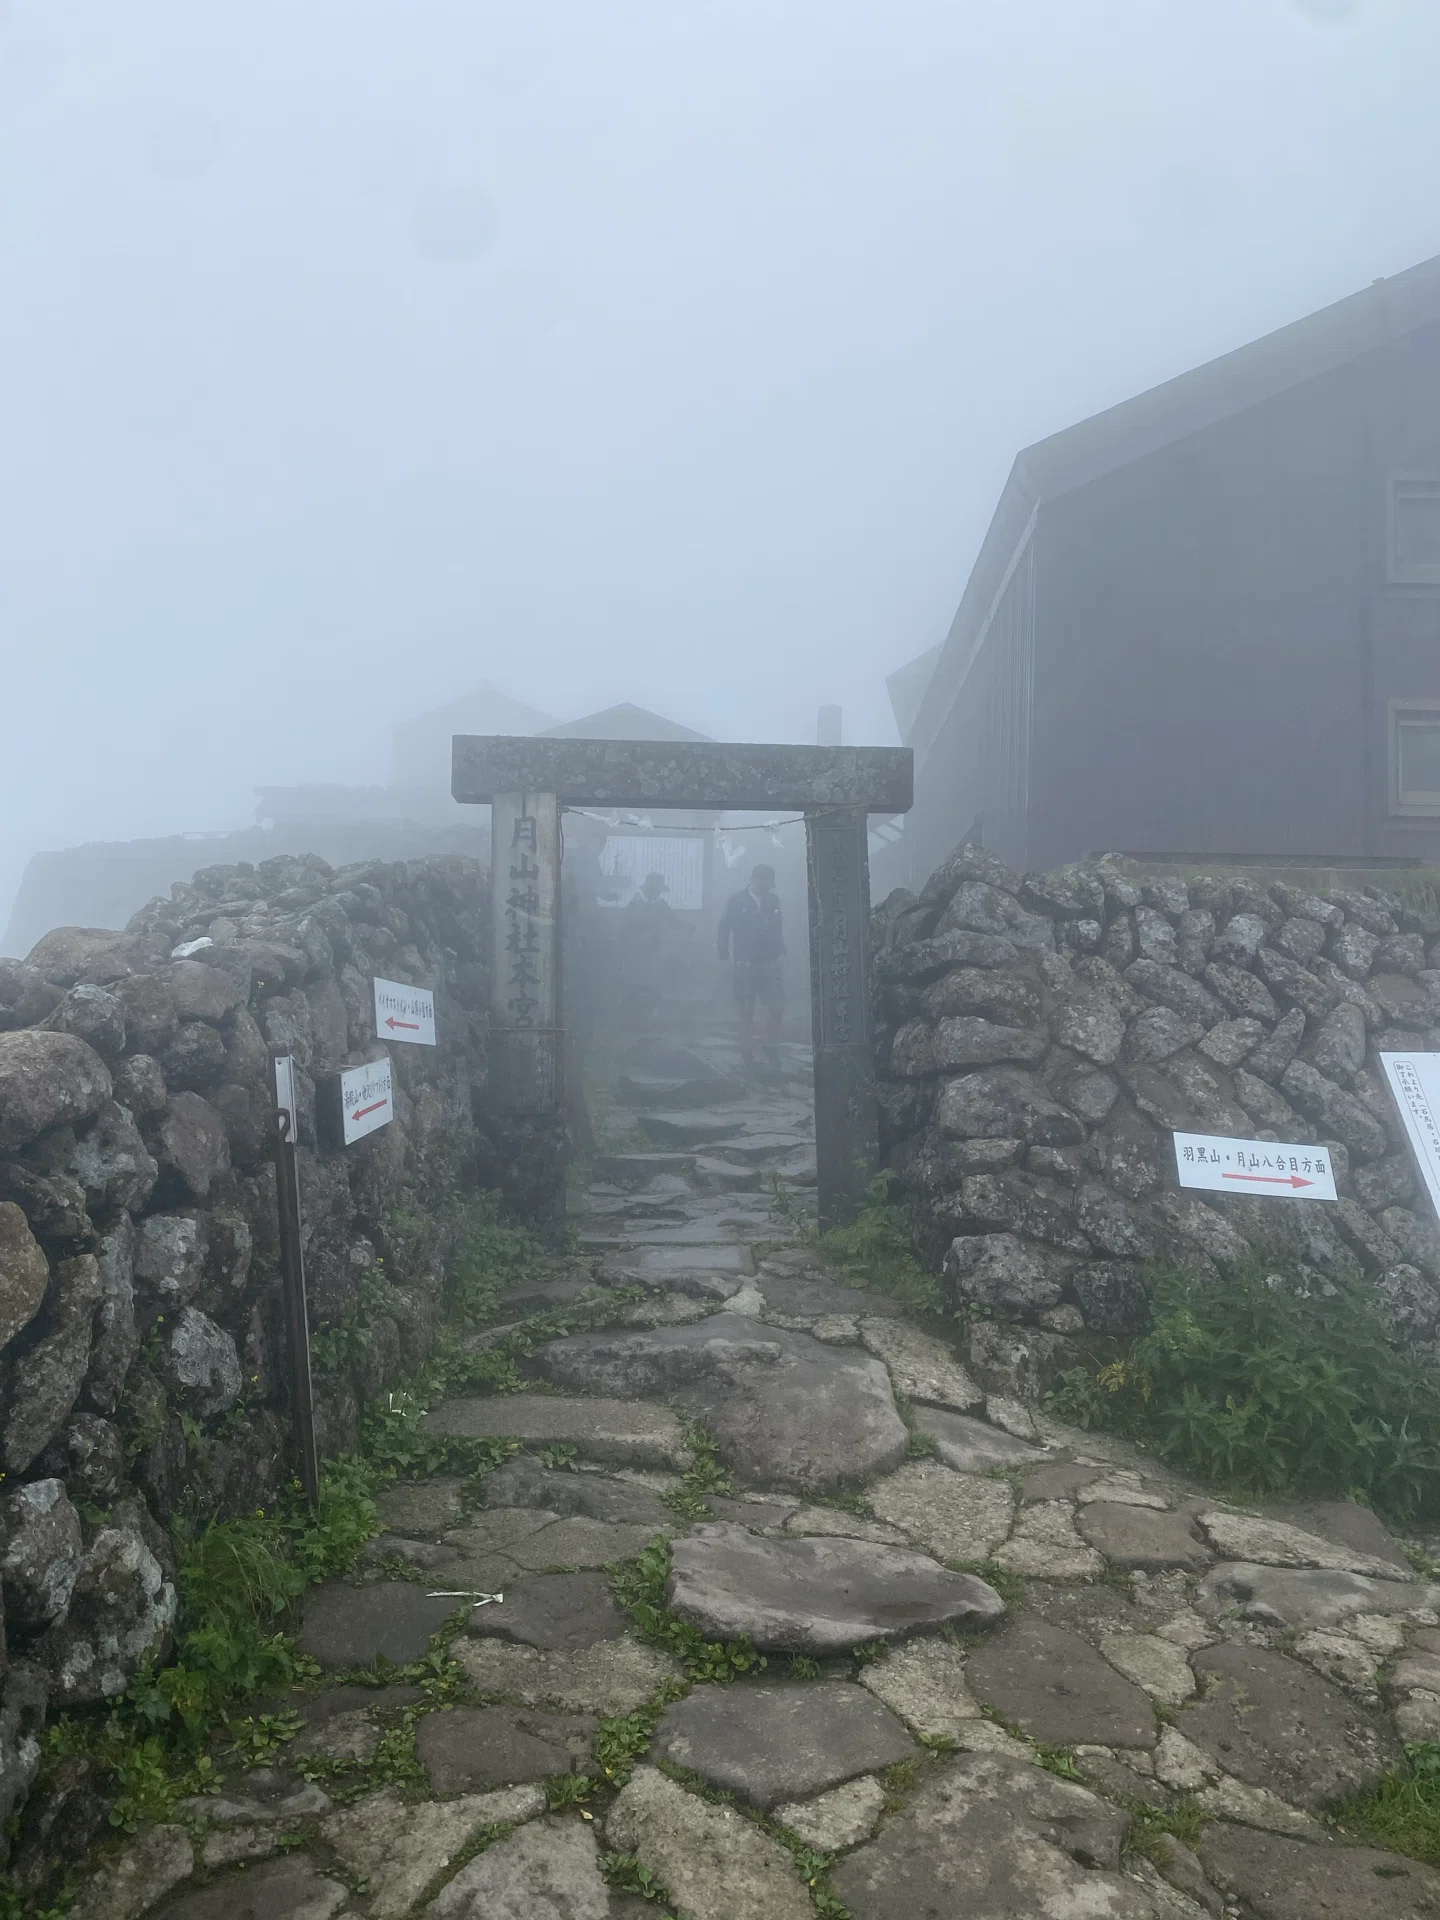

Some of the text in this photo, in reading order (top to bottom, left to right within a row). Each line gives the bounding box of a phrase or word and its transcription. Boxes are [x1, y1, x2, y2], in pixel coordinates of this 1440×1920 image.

[505, 815, 540, 1028] 月山神社本宮
[1183, 1146, 1326, 1174] 羽黒山・月山八合目方面
